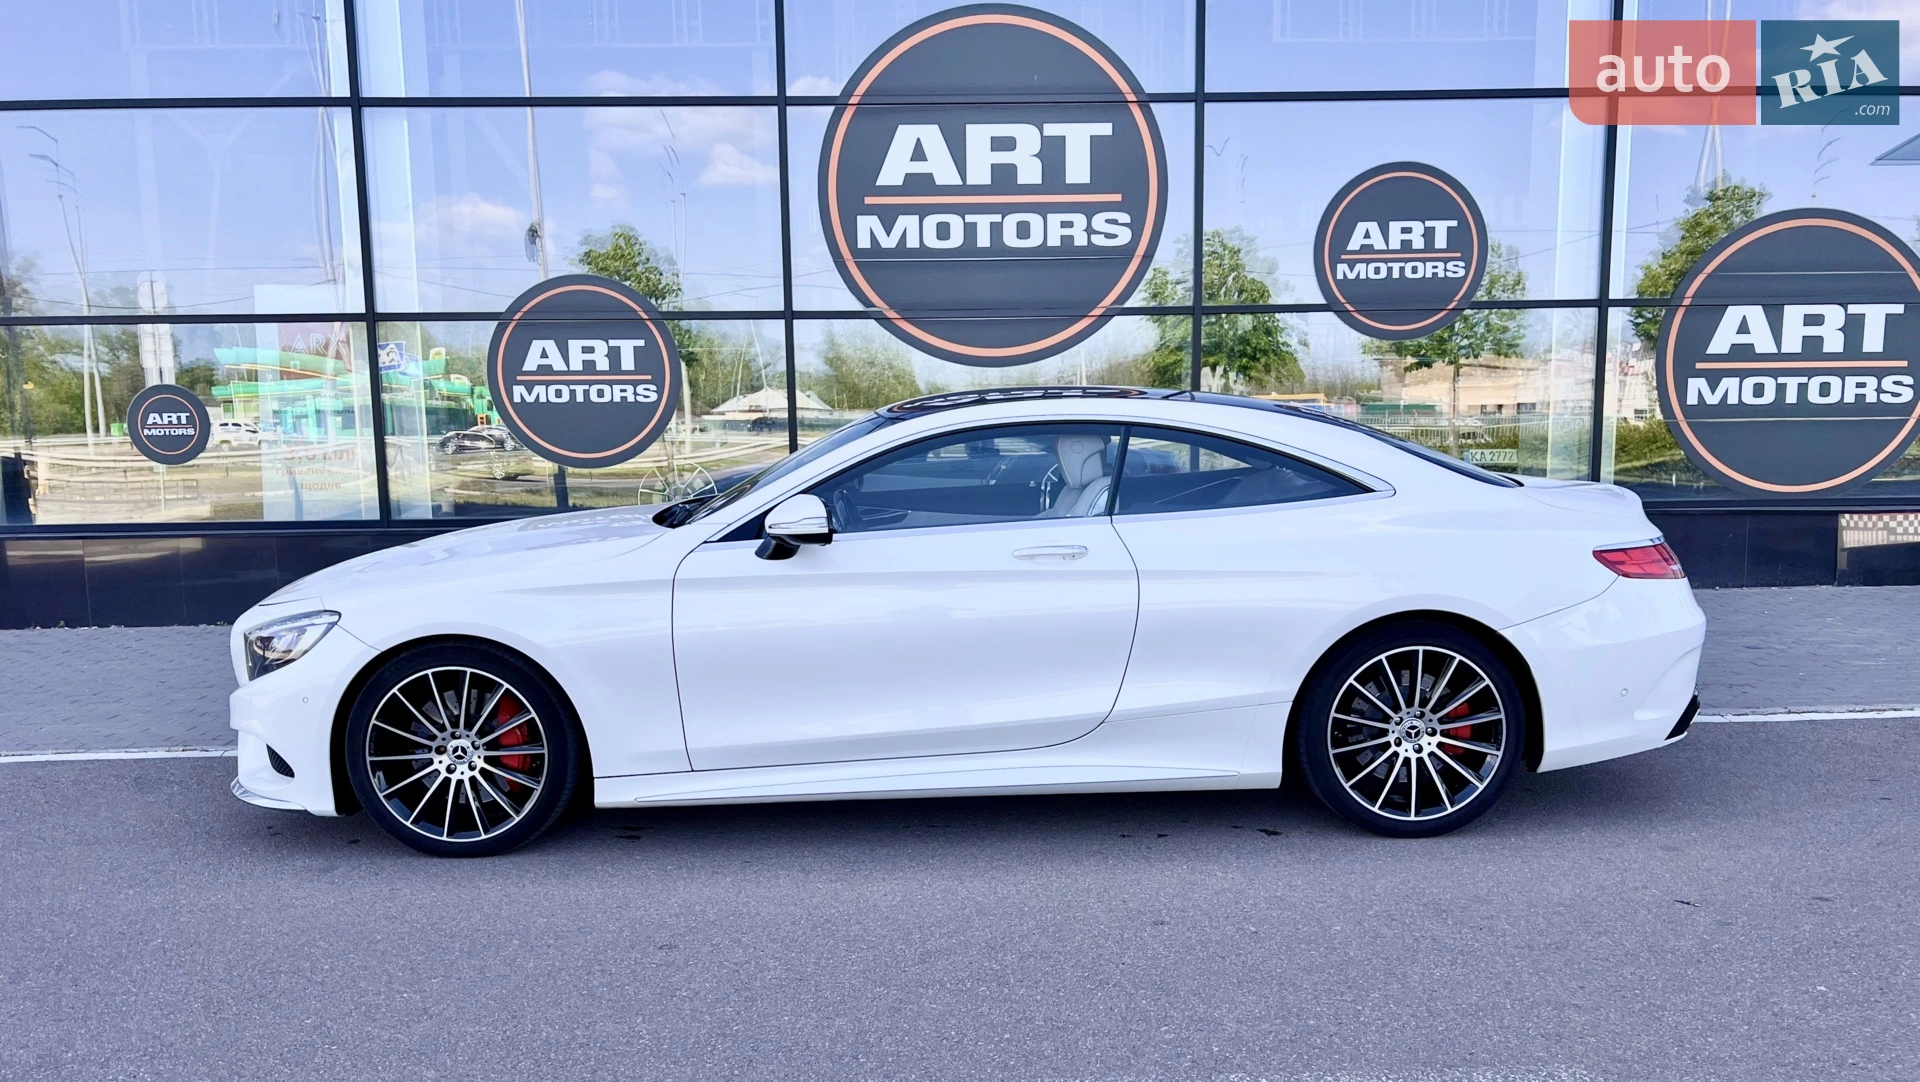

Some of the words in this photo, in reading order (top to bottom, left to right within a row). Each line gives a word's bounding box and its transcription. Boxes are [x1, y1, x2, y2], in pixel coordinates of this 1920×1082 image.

[875, 122, 1113, 187] ART
[856, 211, 1132, 250] MOTORS
[1347, 219, 1459, 251] ART
[1336, 260, 1466, 281] MOTORS
[1705, 303, 1905, 355] ART
[290, 332, 347, 355] ARX
[521, 339, 645, 372] ART
[512, 383, 659, 405] MOTORS
[1686, 374, 1914, 407] MOTORS
[143, 427, 195, 437] MOTORS
[146, 412, 191, 425] ART
[1489, 451, 1514, 462] 2772
